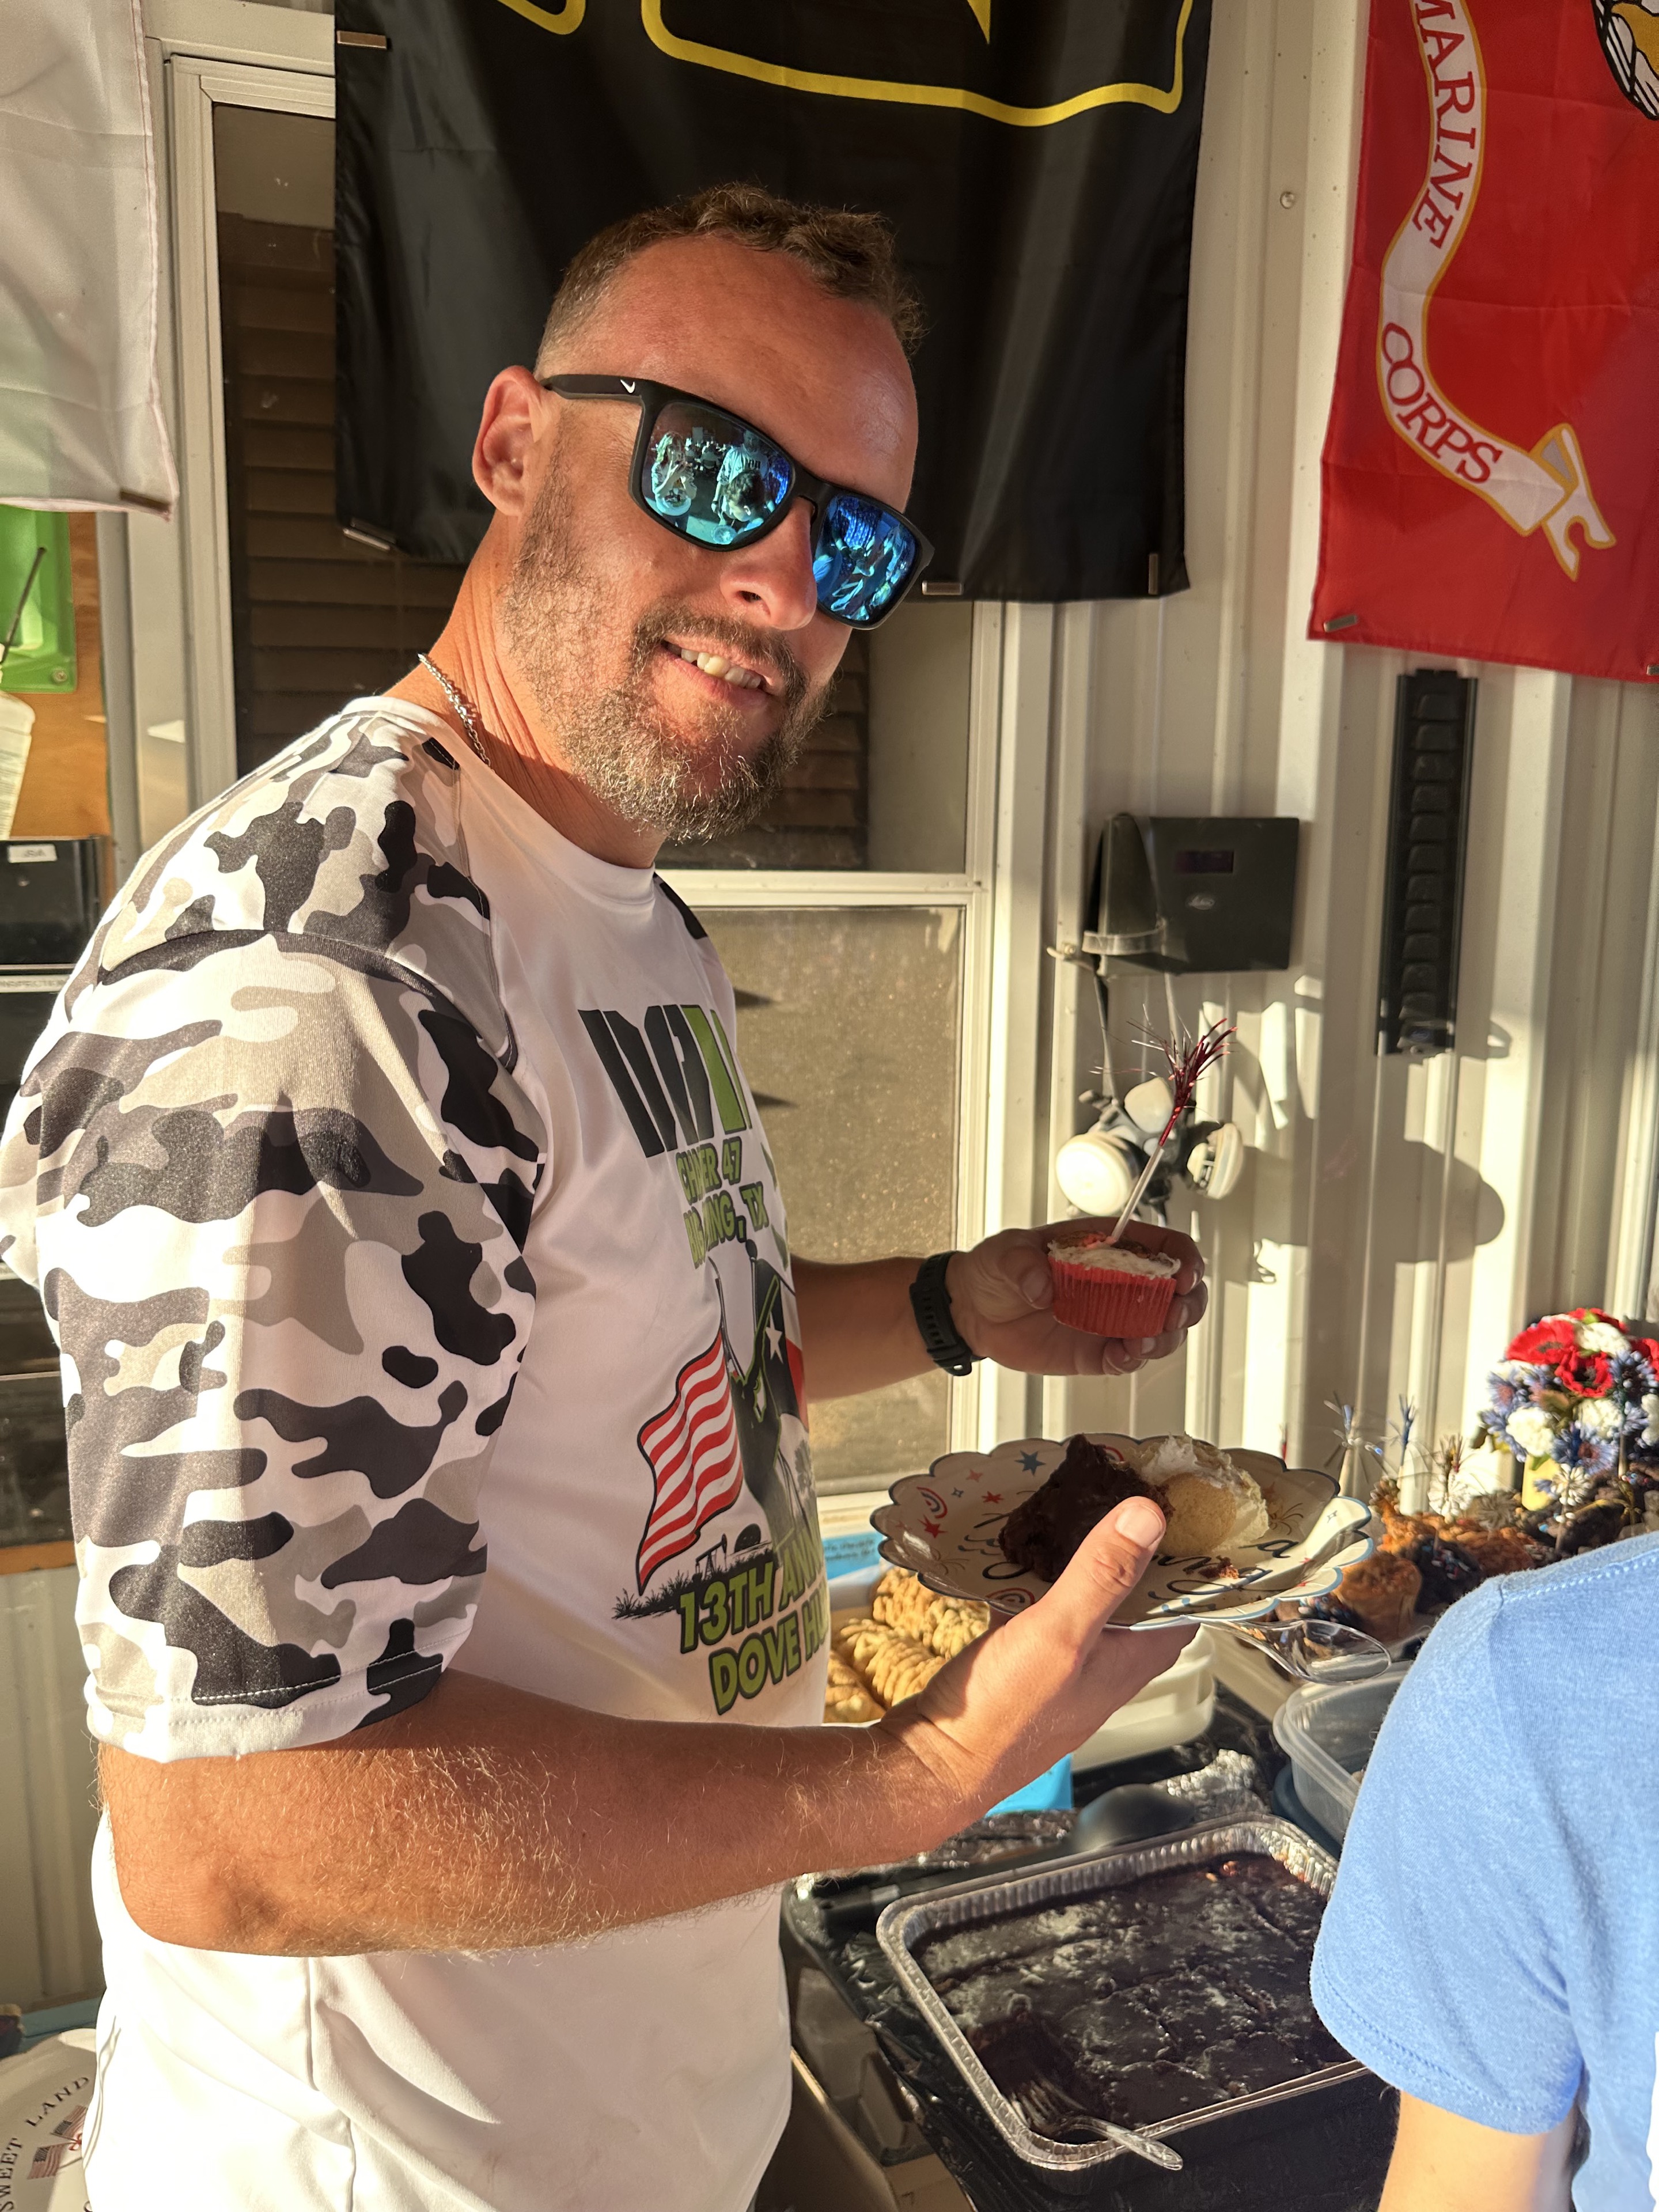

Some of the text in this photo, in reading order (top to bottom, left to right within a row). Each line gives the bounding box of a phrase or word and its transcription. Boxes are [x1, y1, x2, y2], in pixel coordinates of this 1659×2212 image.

[1382, 323, 1503, 483] CORPS
[721, 1136, 742, 1185] 47
[739, 1181, 770, 1232] TX
[679, 1558, 778, 1654] 13TH
[709, 1610, 801, 1716] DOVE
[25, 2076, 90, 2127] LAND
